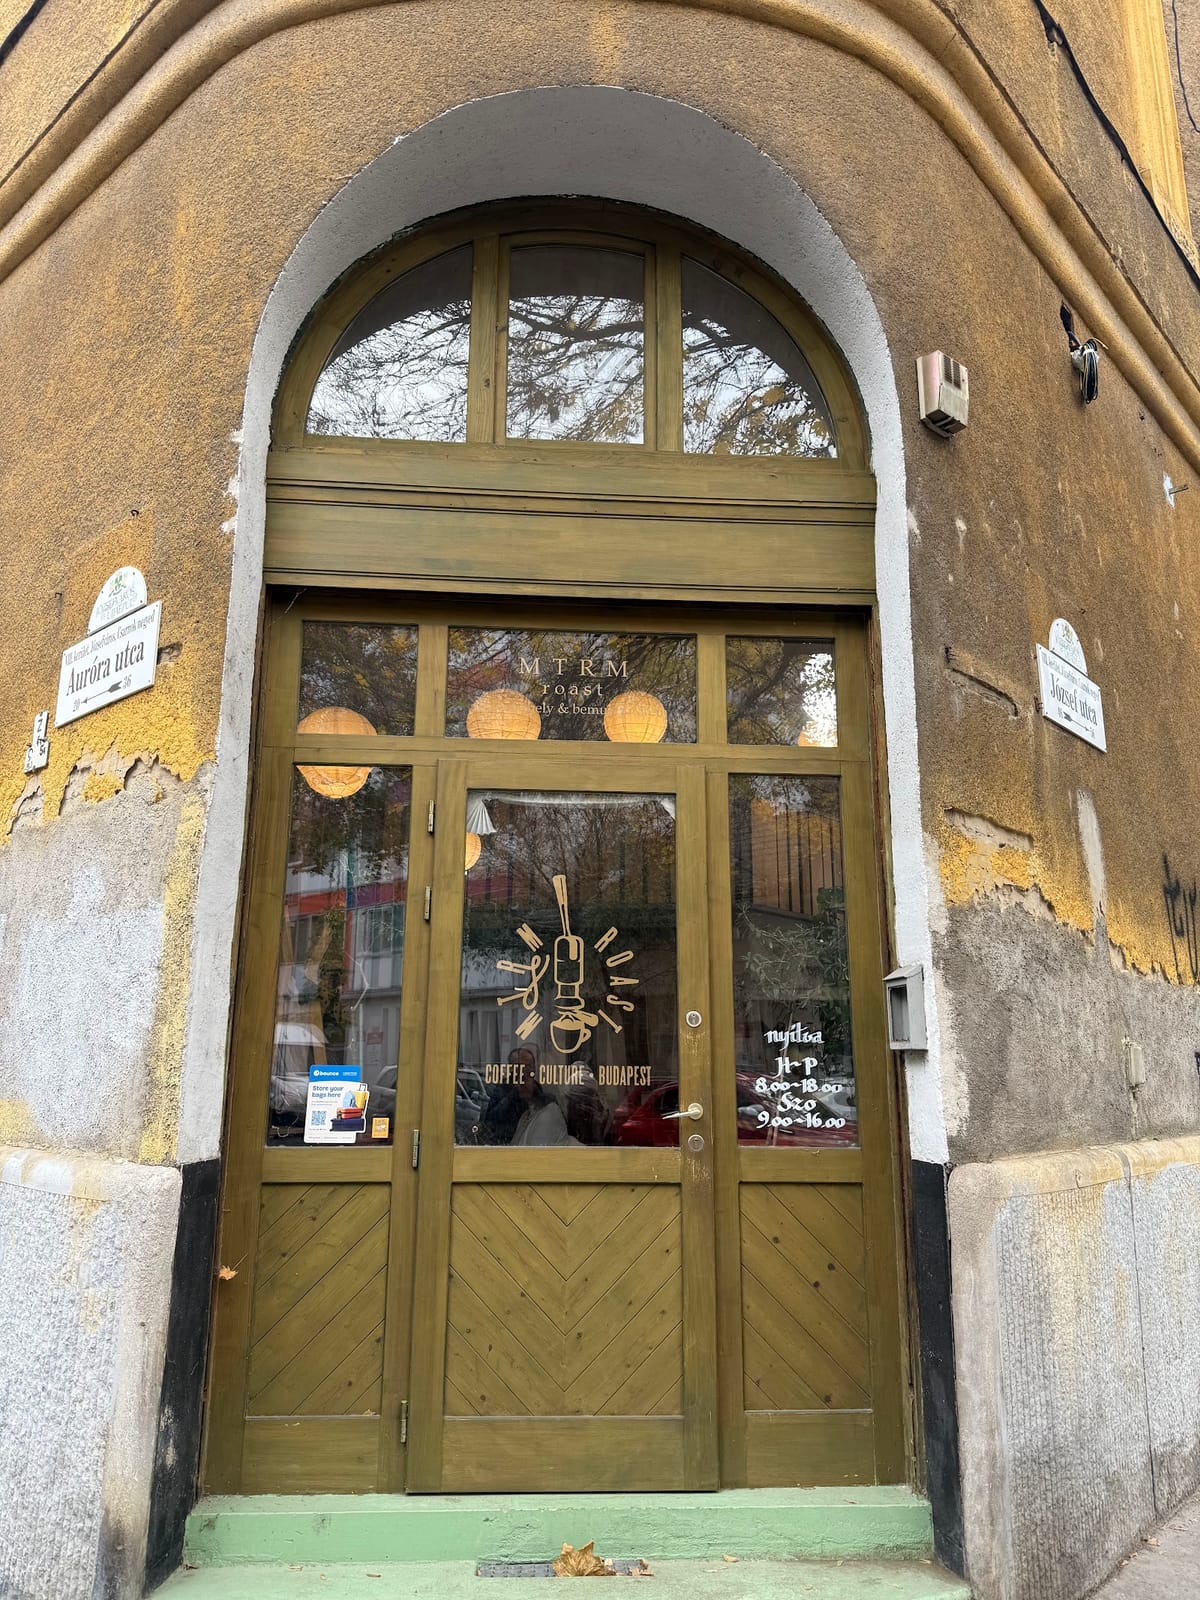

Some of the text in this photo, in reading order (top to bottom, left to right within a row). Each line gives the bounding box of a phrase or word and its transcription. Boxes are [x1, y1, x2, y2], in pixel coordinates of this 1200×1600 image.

[66, 640, 145, 697] Auróra utca
[542, 682, 603, 696] roast
[1050, 673, 1079, 714] József
[1079, 699, 1098, 726] utca
[763, 1021, 825, 1051] nyitva
[485, 1063, 652, 1086] COFFEE CULTURE BUDAPEST
